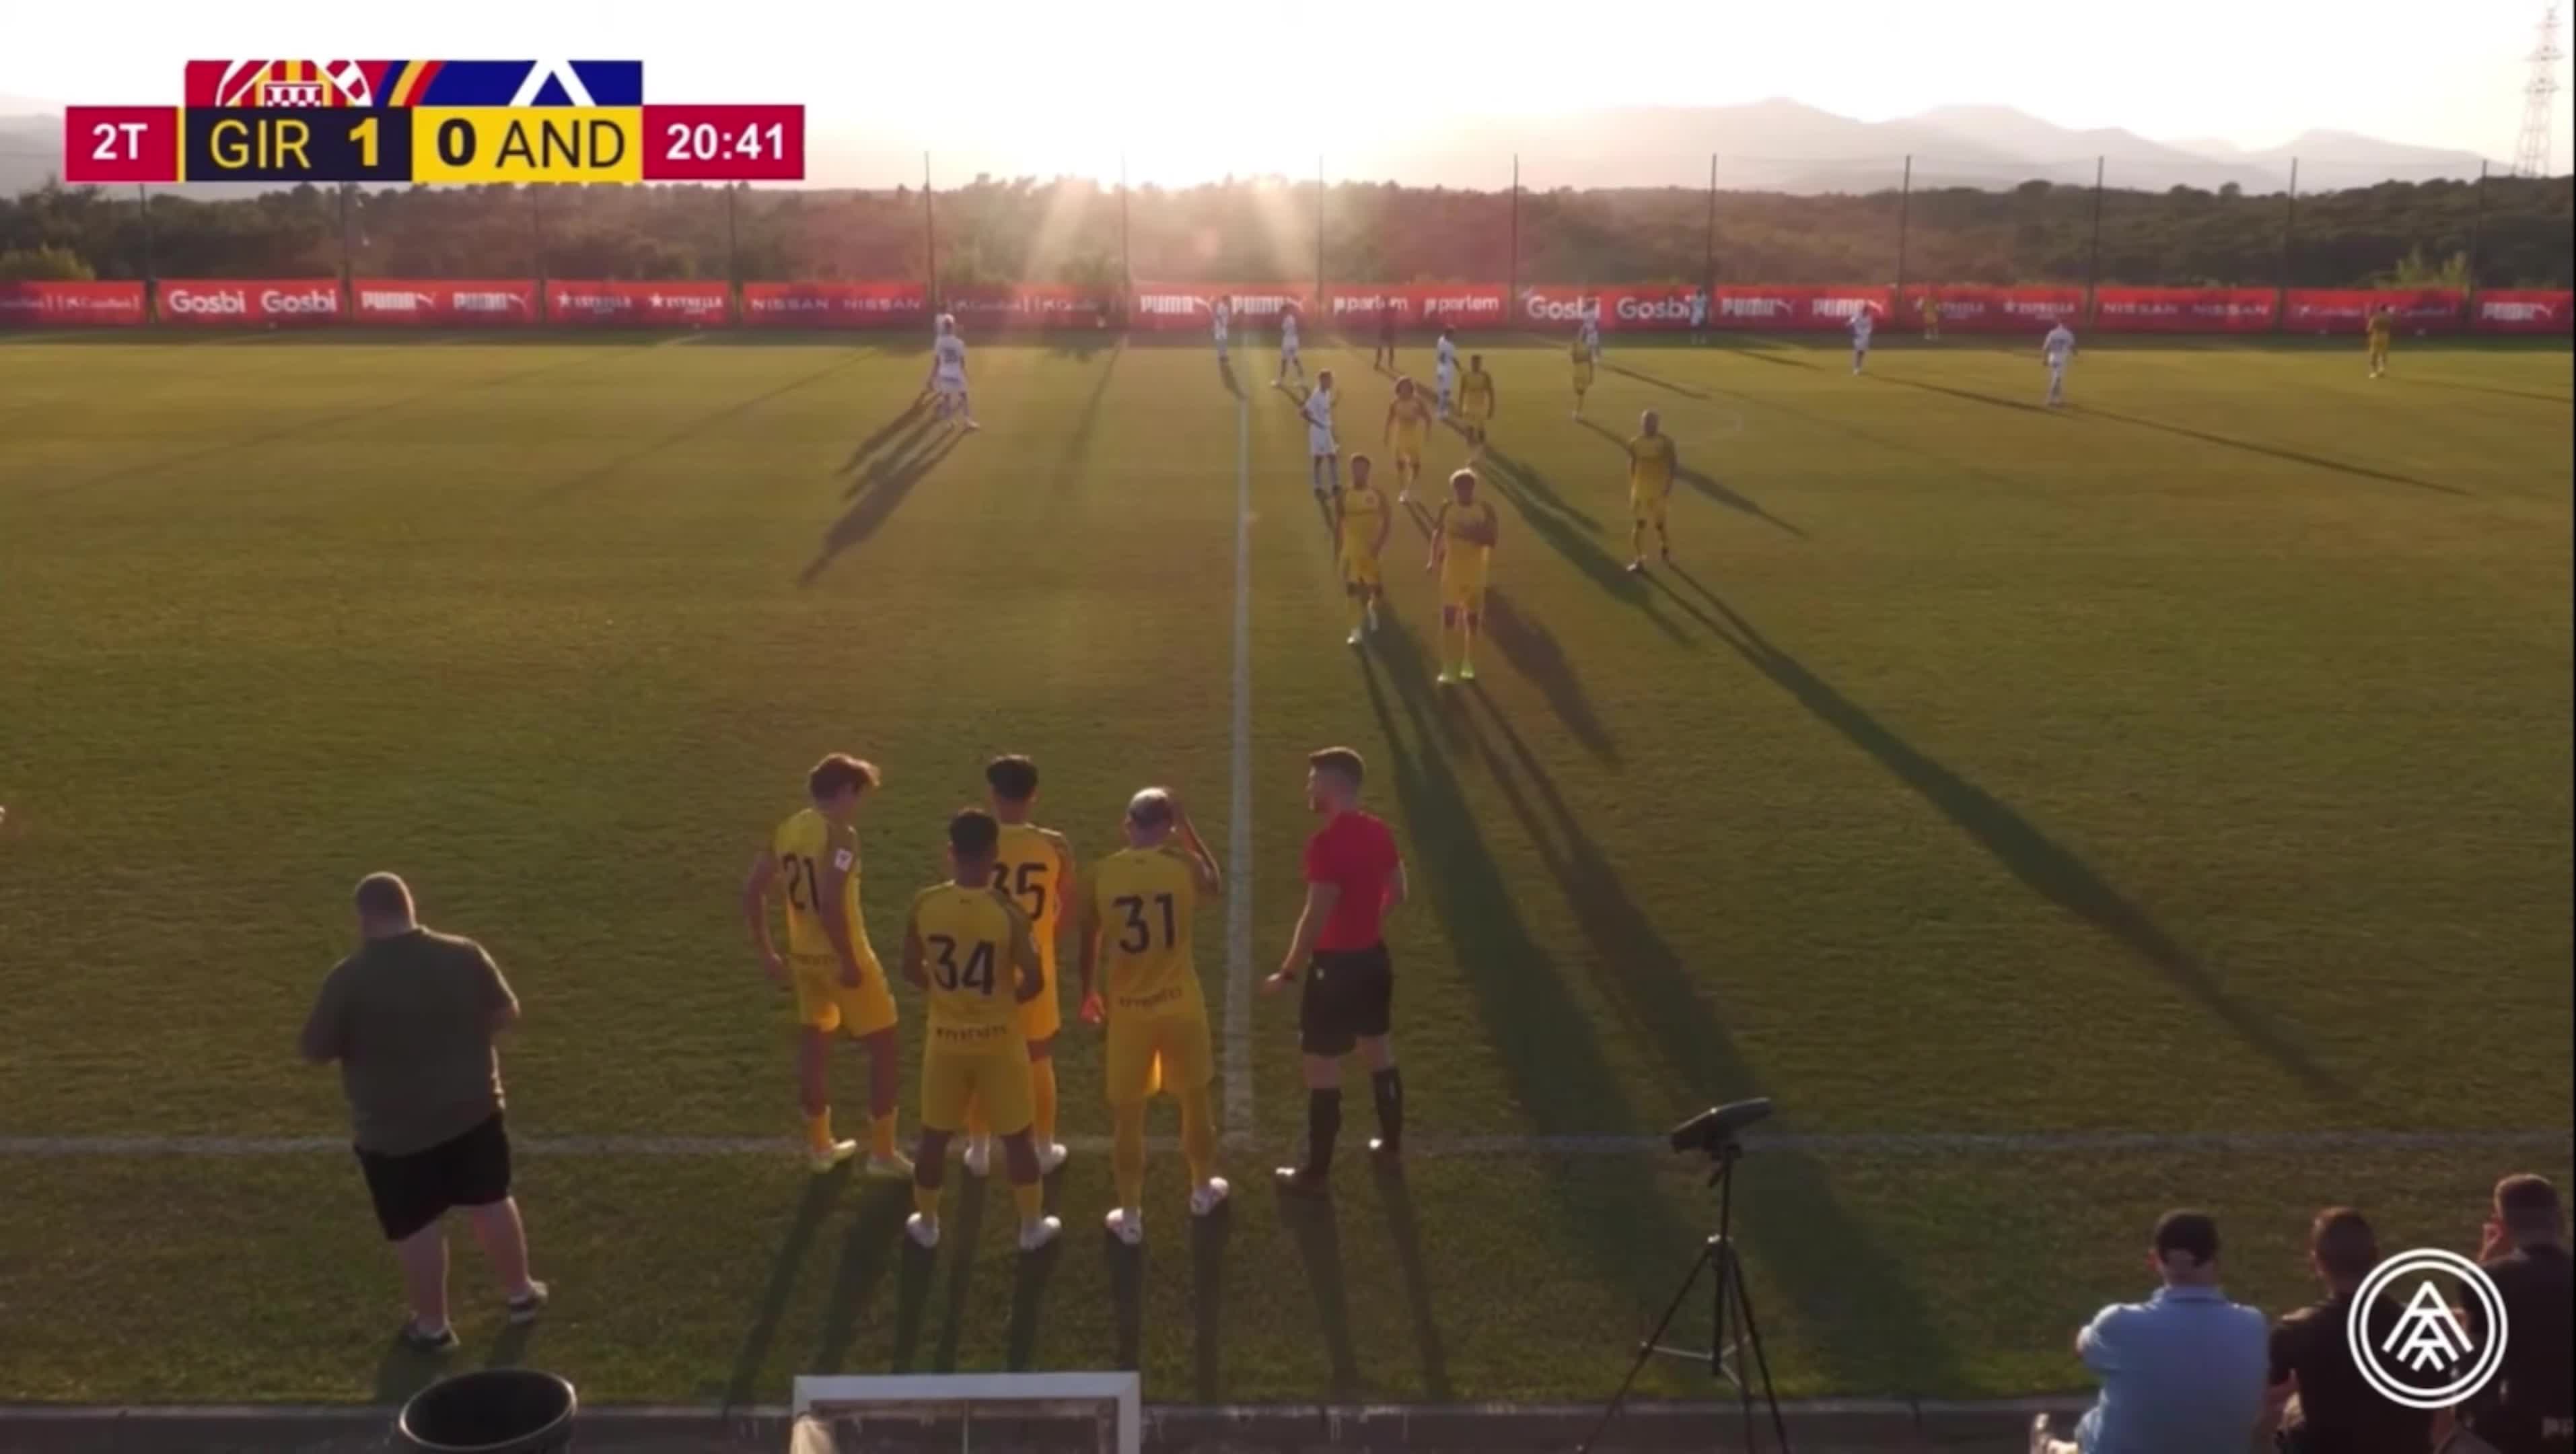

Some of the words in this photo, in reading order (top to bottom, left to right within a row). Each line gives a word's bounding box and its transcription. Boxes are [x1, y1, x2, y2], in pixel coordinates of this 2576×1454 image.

[170, 289, 246, 313] Gosbi
[261, 289, 337, 313] Gosbi
[752, 298, 829, 312] NISSAN
[843, 298, 921, 312] NISSAN
[1140, 296, 1194, 314] PUMA
[1617, 296, 1690, 319] Gosbi
[783, 854, 820, 911] 21
[1112, 893, 1175, 953] 31
[928, 934, 994, 996] 34
